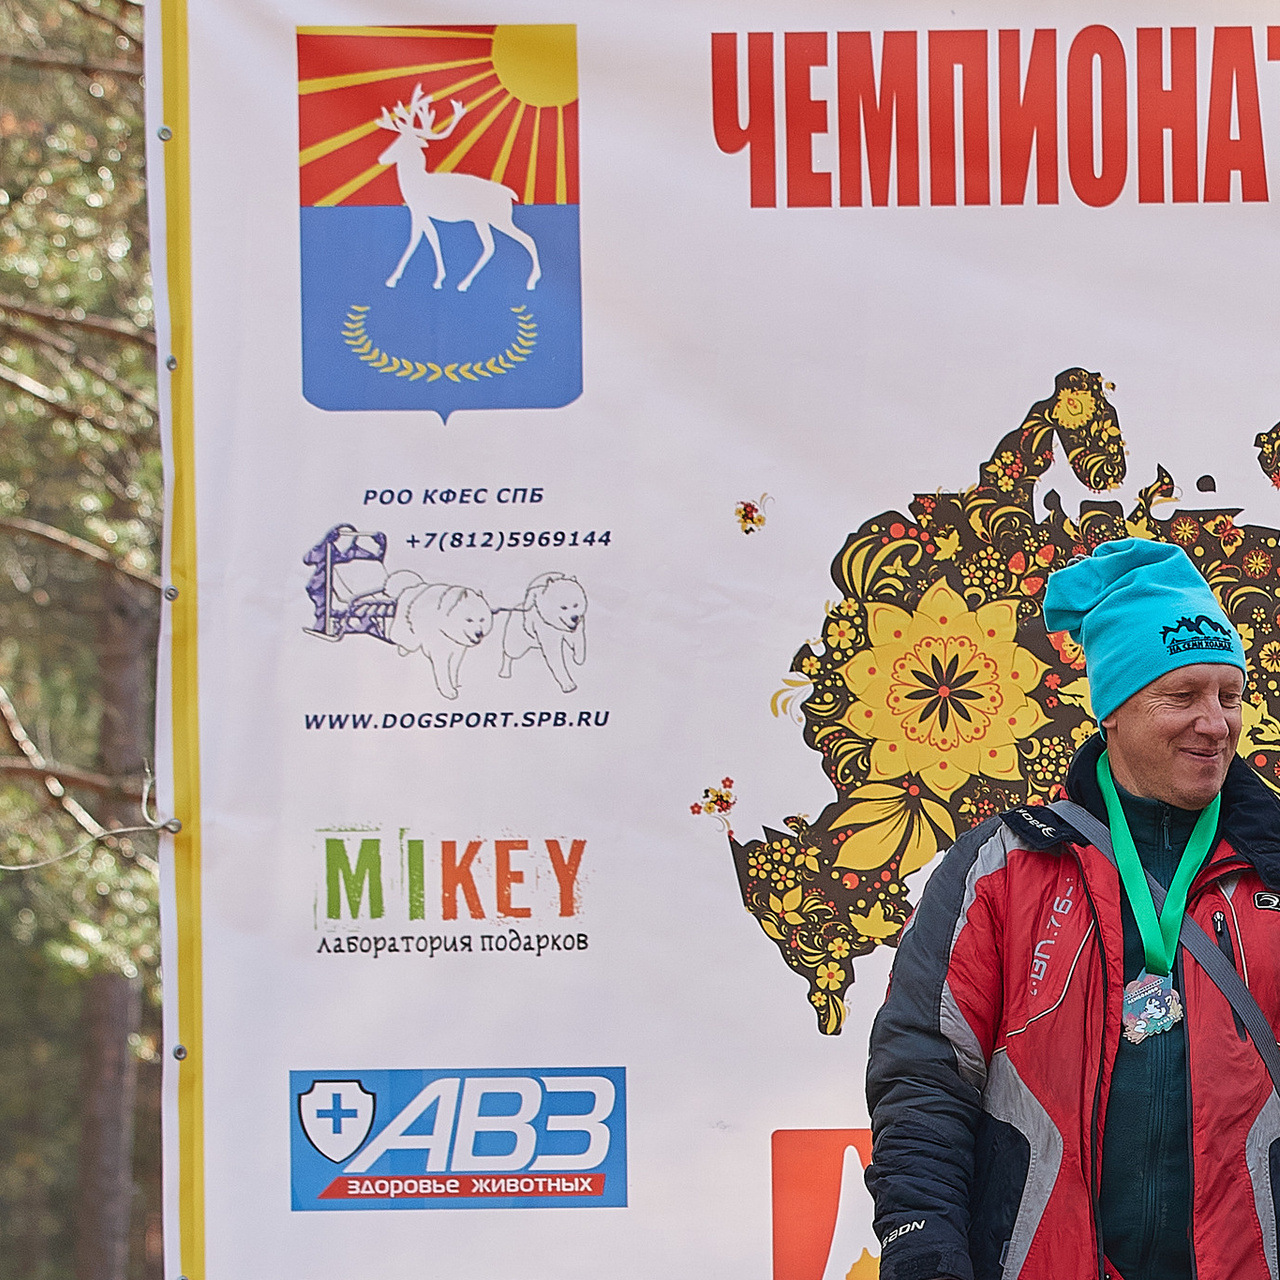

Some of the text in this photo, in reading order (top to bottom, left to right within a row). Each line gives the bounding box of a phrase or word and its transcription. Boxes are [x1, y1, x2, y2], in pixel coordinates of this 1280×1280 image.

[363, 487, 545, 506] РОО КФЕС СПБ
[405, 530, 612, 552] +7(812)5969144
[304, 711, 611, 730] WWW.DOGSPORT.SPB.RU
[324, 837, 588, 921] MIKEY
[317, 931, 589, 957] лаборатория подарков
[1134, 1020, 1147, 1033] 2
[343, 1076, 616, 1174] АВЗ
